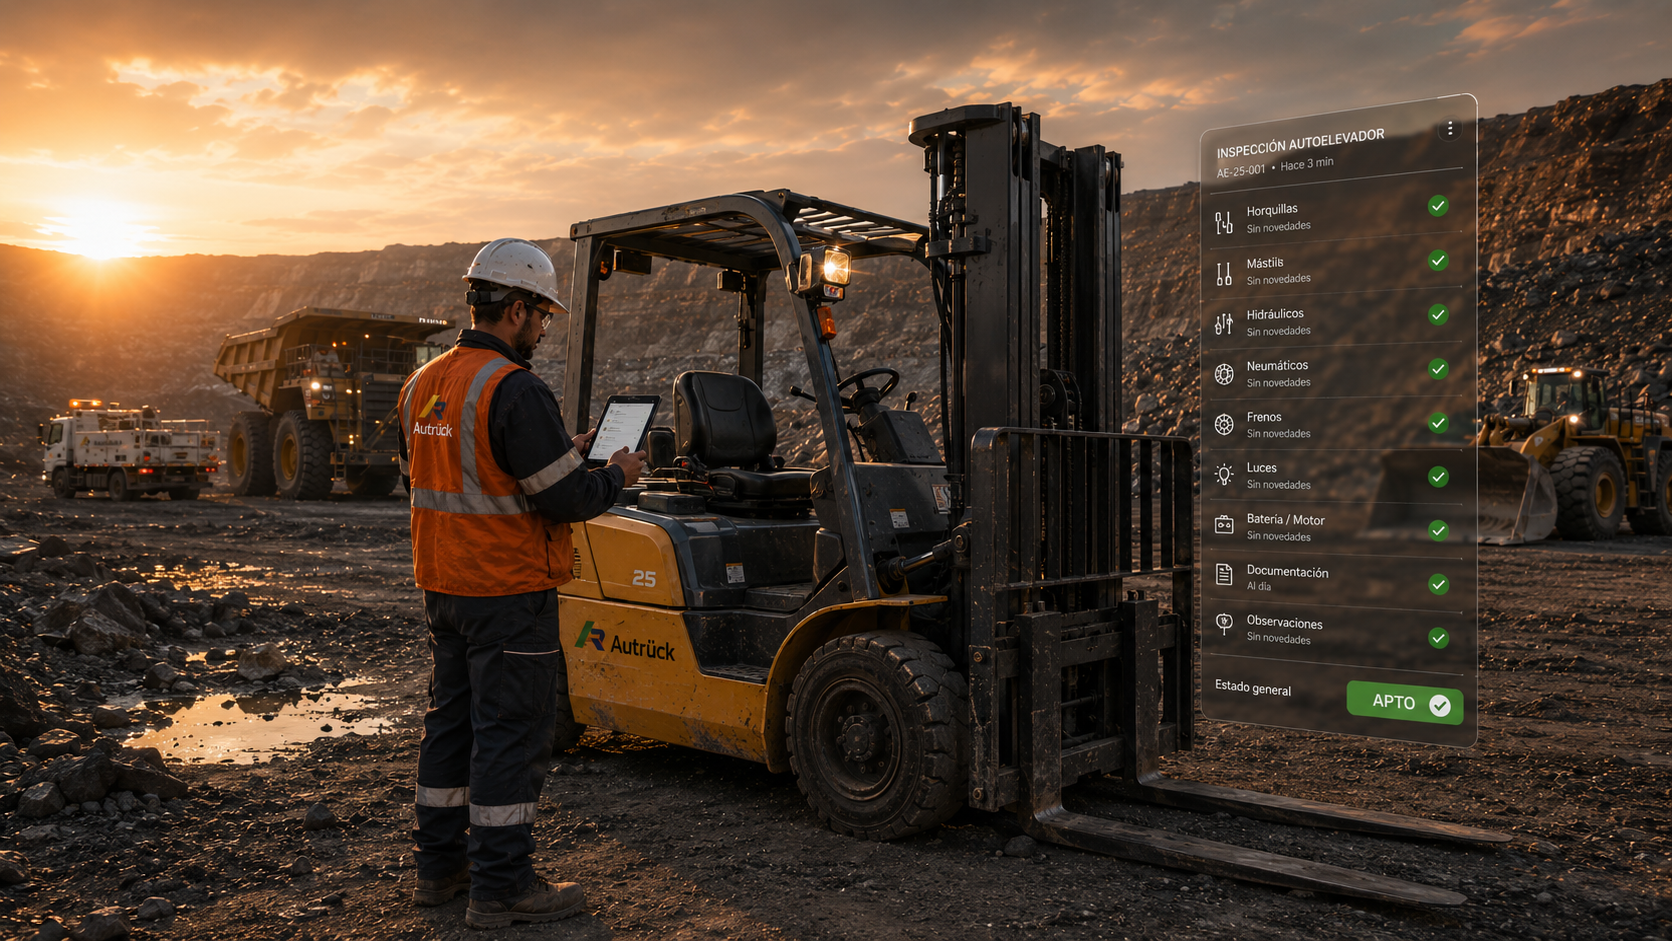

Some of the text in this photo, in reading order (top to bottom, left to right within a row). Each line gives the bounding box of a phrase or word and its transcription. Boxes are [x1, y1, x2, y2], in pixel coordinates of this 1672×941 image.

[413, 421, 453, 438] Autrück
[632, 569, 656, 588] 25
[610, 635, 675, 661] Autrück
